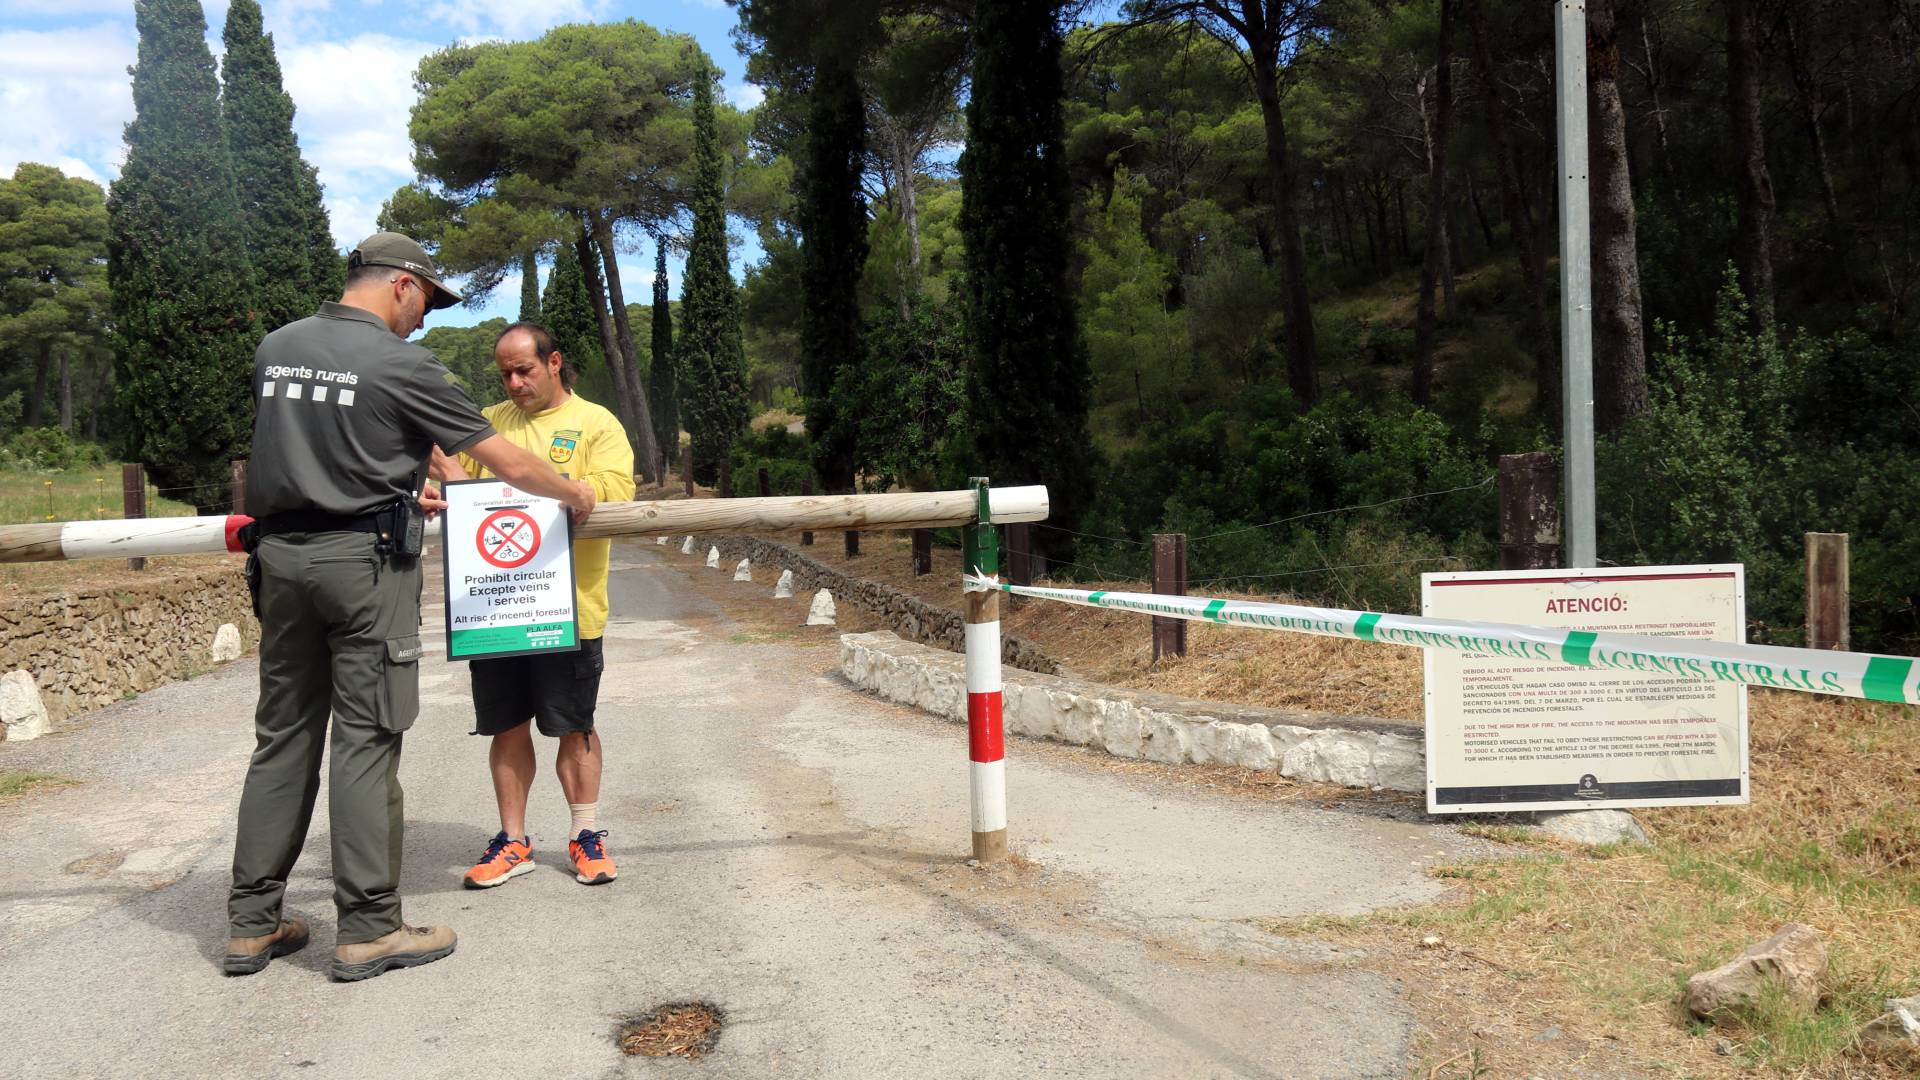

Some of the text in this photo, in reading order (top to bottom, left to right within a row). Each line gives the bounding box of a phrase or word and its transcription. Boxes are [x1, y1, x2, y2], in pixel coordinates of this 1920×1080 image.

[265, 365, 358, 384] agents rurals
[464, 570, 556, 584] Prohibit circular
[470, 582, 550, 596] Excepte veïns
[488, 595, 536, 606] i serveis
[1546, 592, 1628, 614] ATENCIÓ:
[454, 606, 571, 624] Alt risc d'incendi forestal
[1598, 649, 1845, 692] AGENTS RURALS
